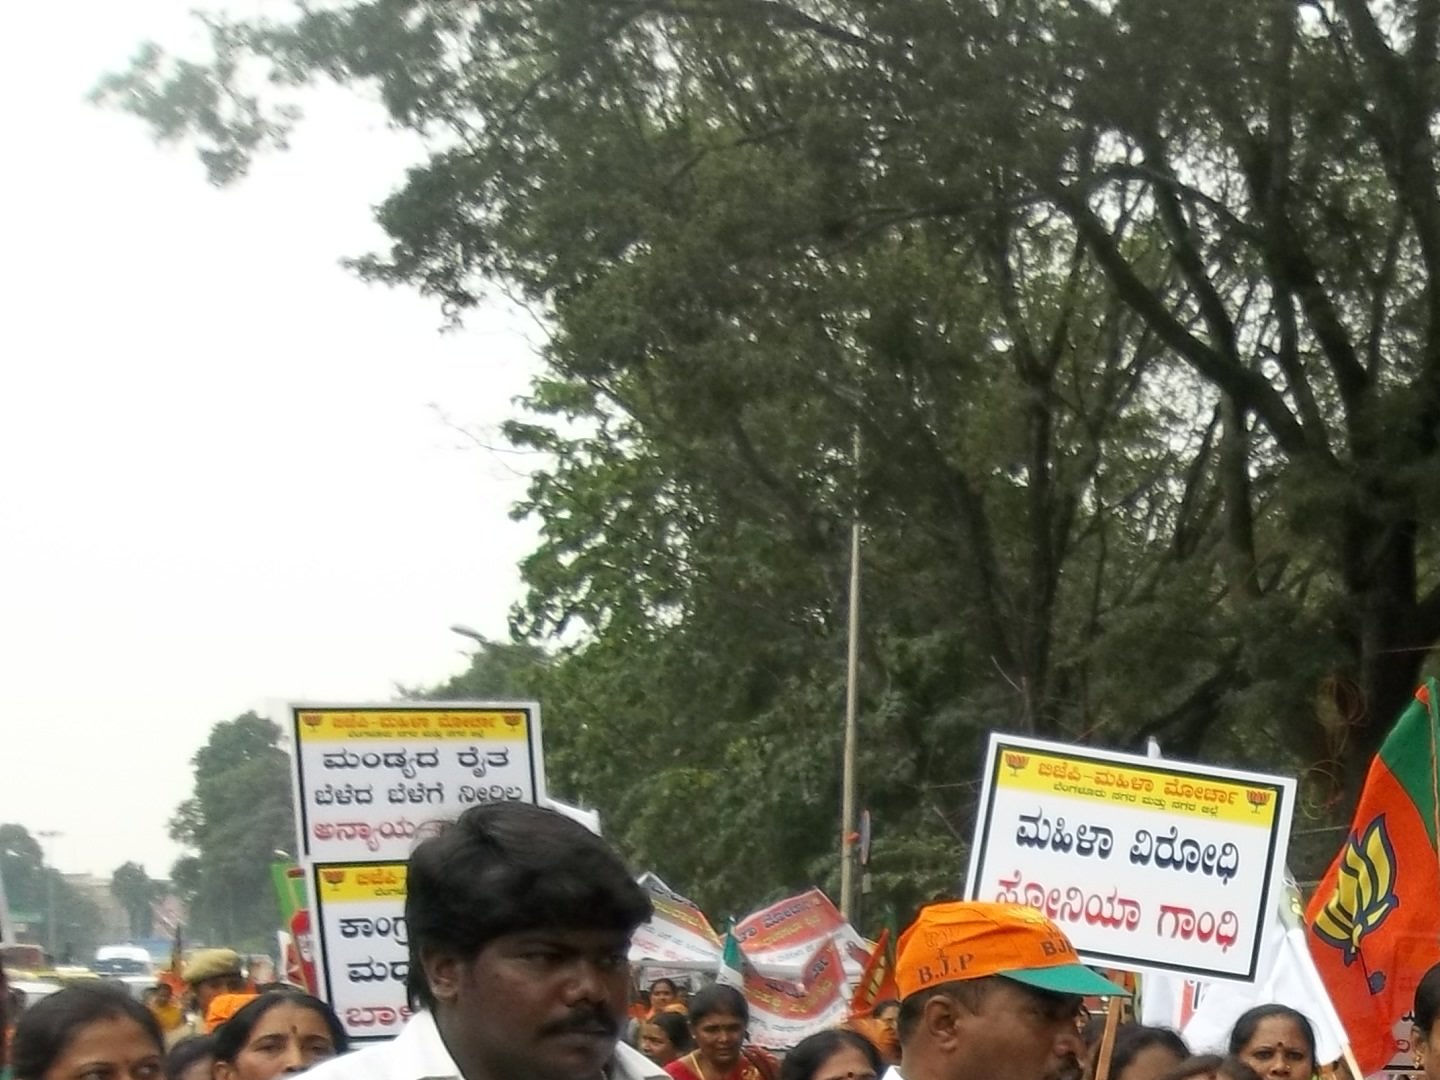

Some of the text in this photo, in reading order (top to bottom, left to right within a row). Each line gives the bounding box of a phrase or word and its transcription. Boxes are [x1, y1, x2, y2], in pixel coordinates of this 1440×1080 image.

[323, 746, 510, 779] ಮಂಡ್ಯದ ರೈತ
[315, 783, 373, 805] ಬೆಳೆದ
[388, 783, 444, 804] ಬೆಳೆಗೆ
[1164, 778, 1239, 806] ಮೋರ್ಚಾ
[1015, 805, 1240, 886] ಮಹಿಳಾ ವಿರೋಧಿ
[1157, 903, 1240, 953] ಗಾಂಧಿ
